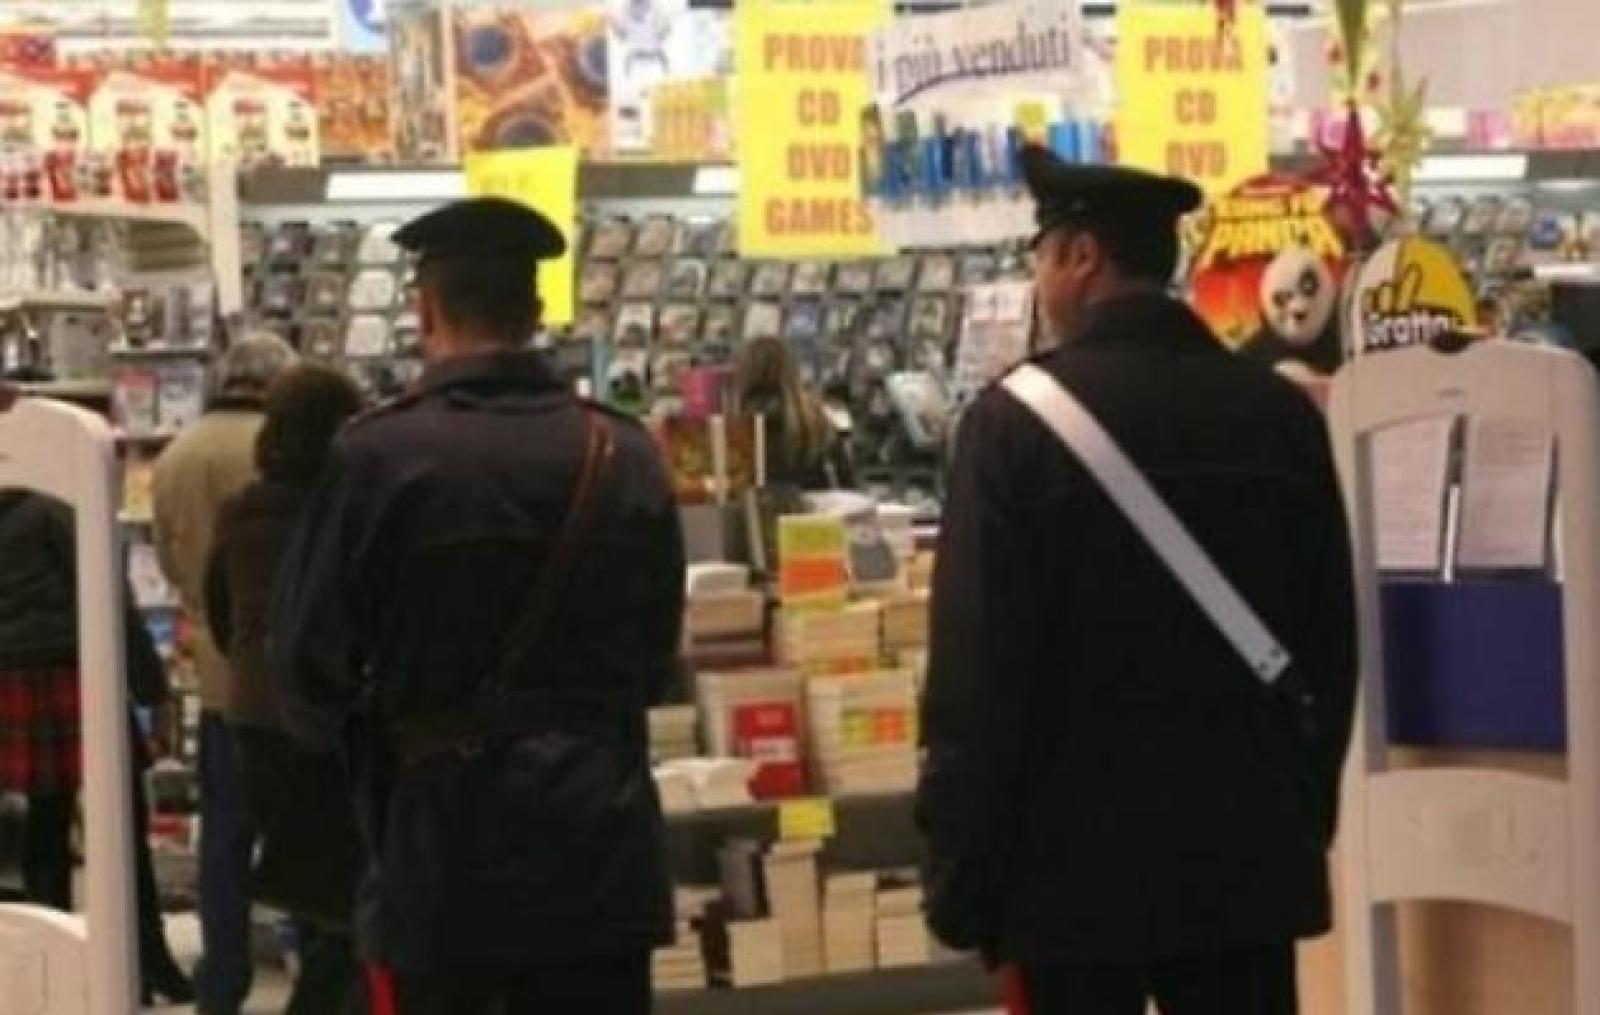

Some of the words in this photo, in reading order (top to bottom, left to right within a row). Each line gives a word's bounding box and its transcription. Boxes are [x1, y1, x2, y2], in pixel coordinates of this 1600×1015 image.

[877, 39, 886, 92] i
[951, 15, 1070, 77] venduti
[1144, 36, 1243, 72] PROVA
[798, 90, 840, 124] CD
[1175, 90, 1217, 125] CD
[788, 144, 850, 179] DVD
[1166, 142, 1226, 176] DVD
[766, 198, 873, 234] GAMES
